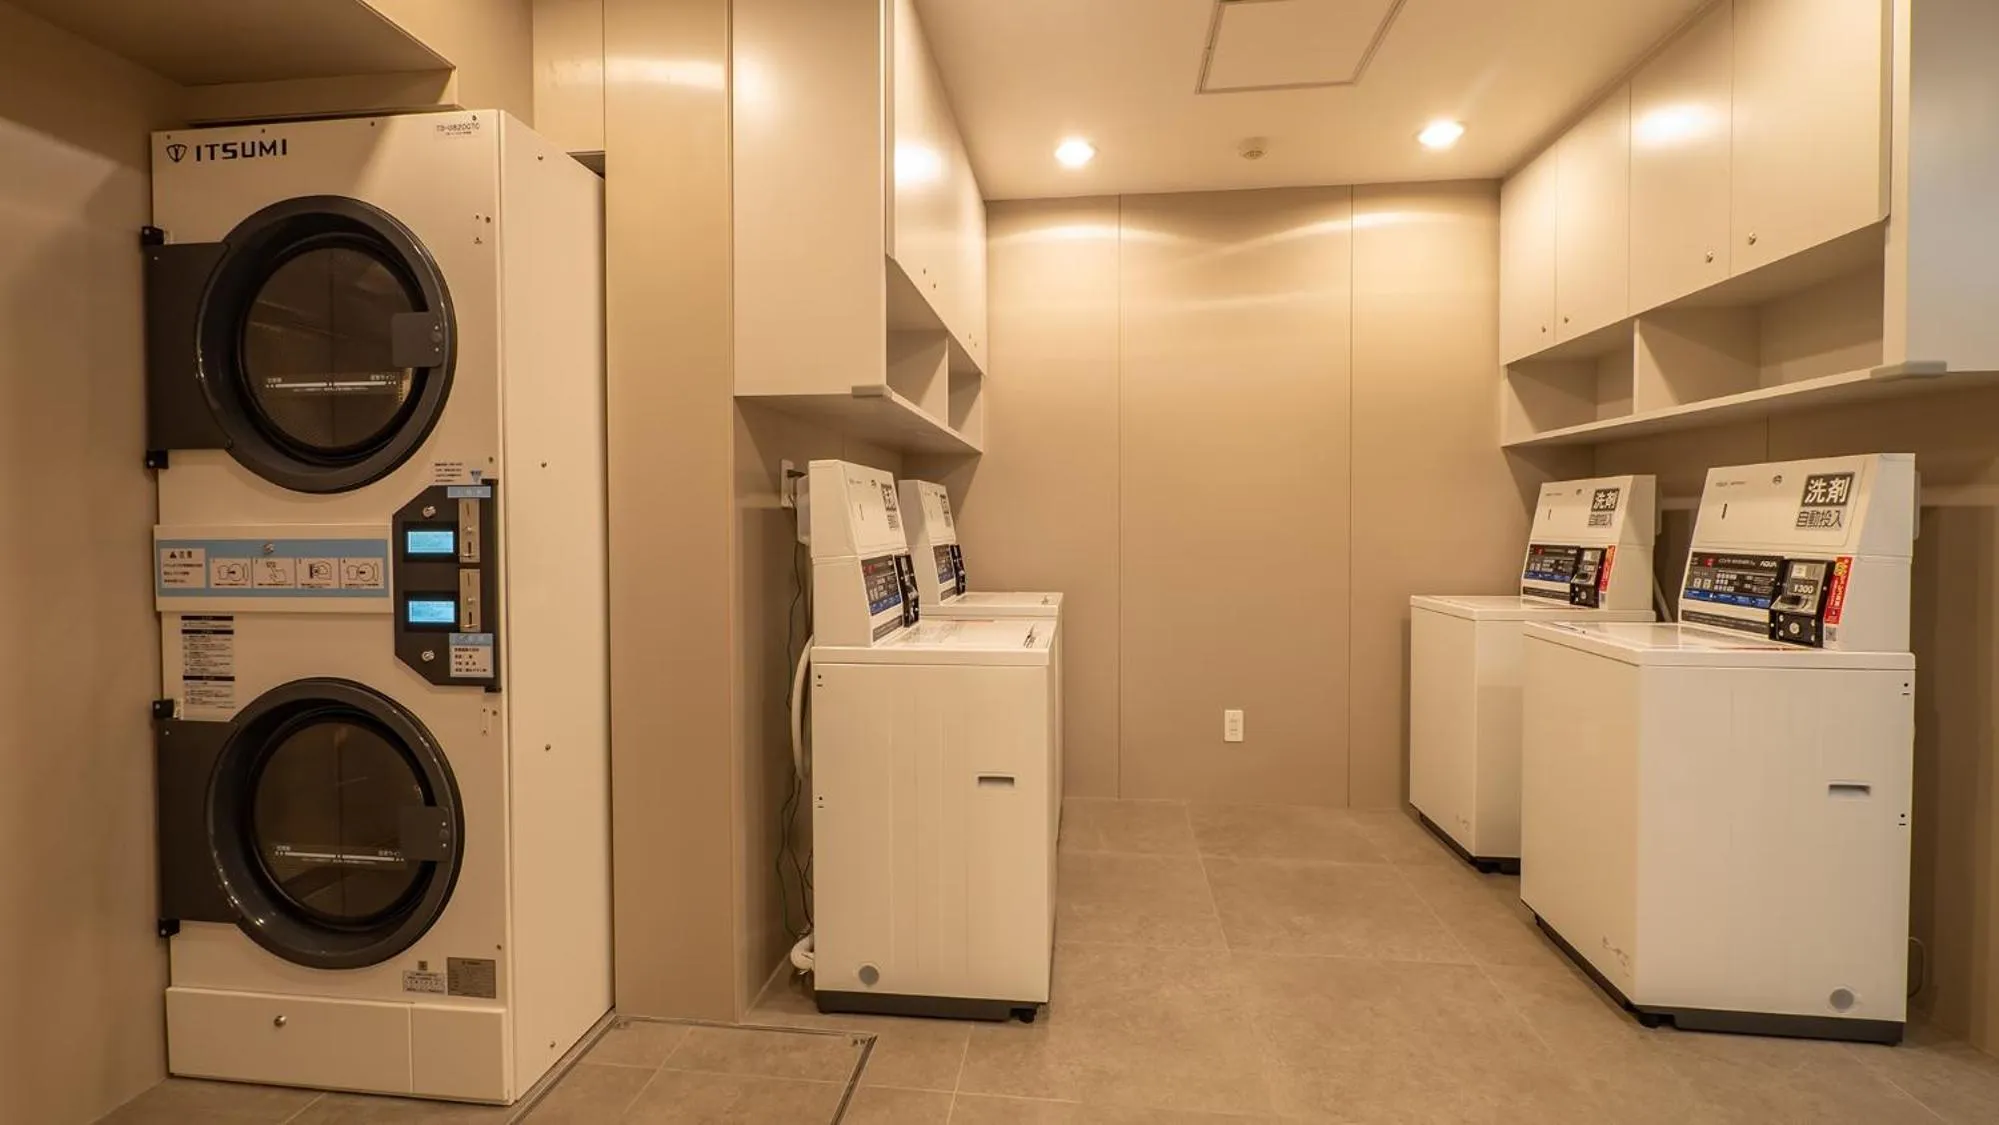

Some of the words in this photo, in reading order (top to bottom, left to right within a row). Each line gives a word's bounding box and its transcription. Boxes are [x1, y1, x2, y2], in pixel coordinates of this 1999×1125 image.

[196, 139, 287, 161] ITSUMI
[1804, 476, 1851, 503] 洗剤
[1796, 509, 1842, 528] 自動投入
